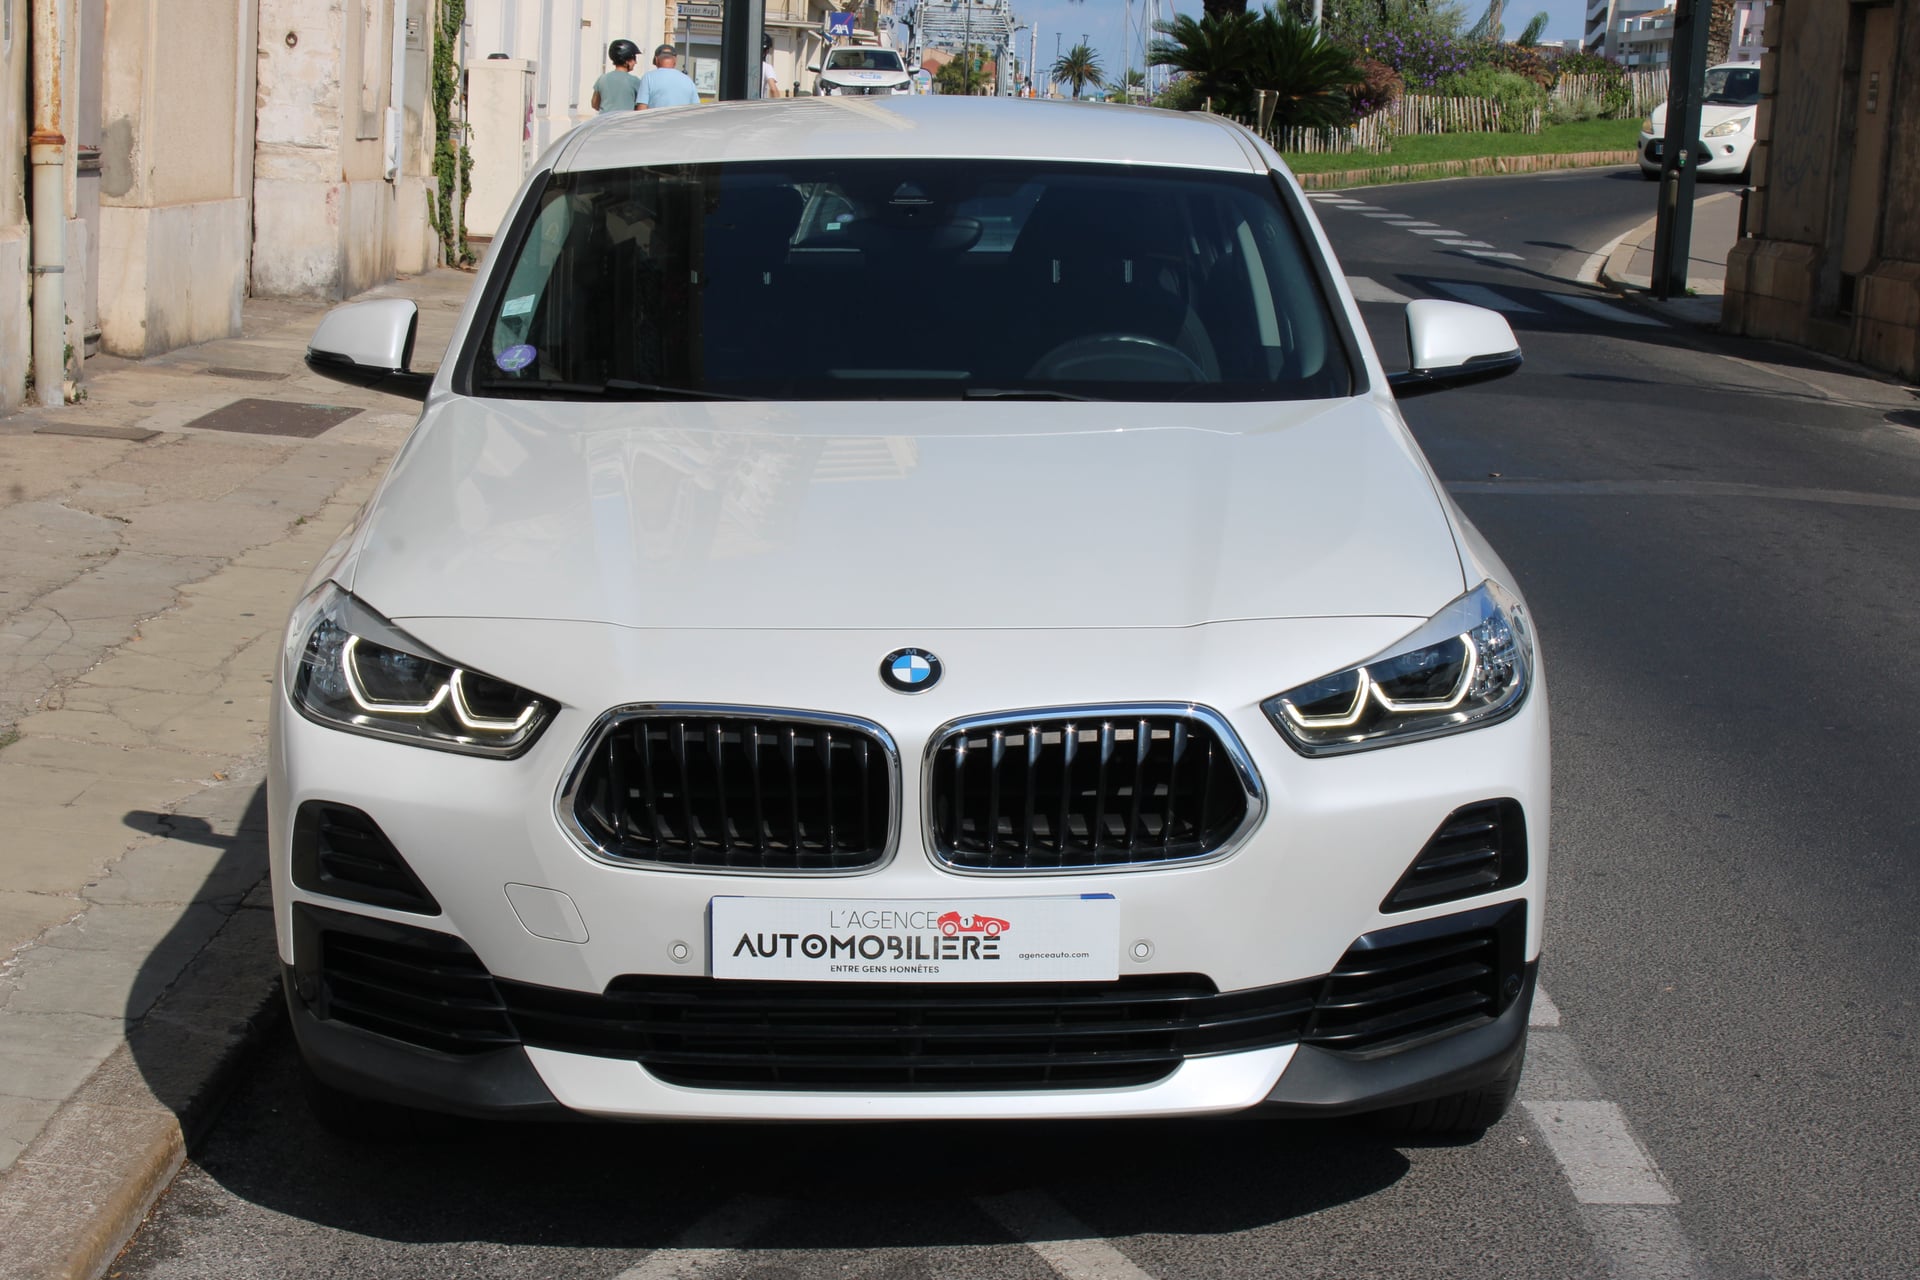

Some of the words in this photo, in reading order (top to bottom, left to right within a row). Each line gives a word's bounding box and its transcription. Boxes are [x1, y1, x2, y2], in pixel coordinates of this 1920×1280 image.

[830, 23, 850, 35] AXA
[887, 649, 937, 662] BMW
[830, 910, 938, 930] L'AGENCE
[963, 917, 970, 927] 1
[1018, 951, 1090, 960] agenceauto.com
[830, 964, 860, 973] ENTRE
[862, 965, 888, 974] GENS
[889, 964, 940, 974] HONNÊTES
